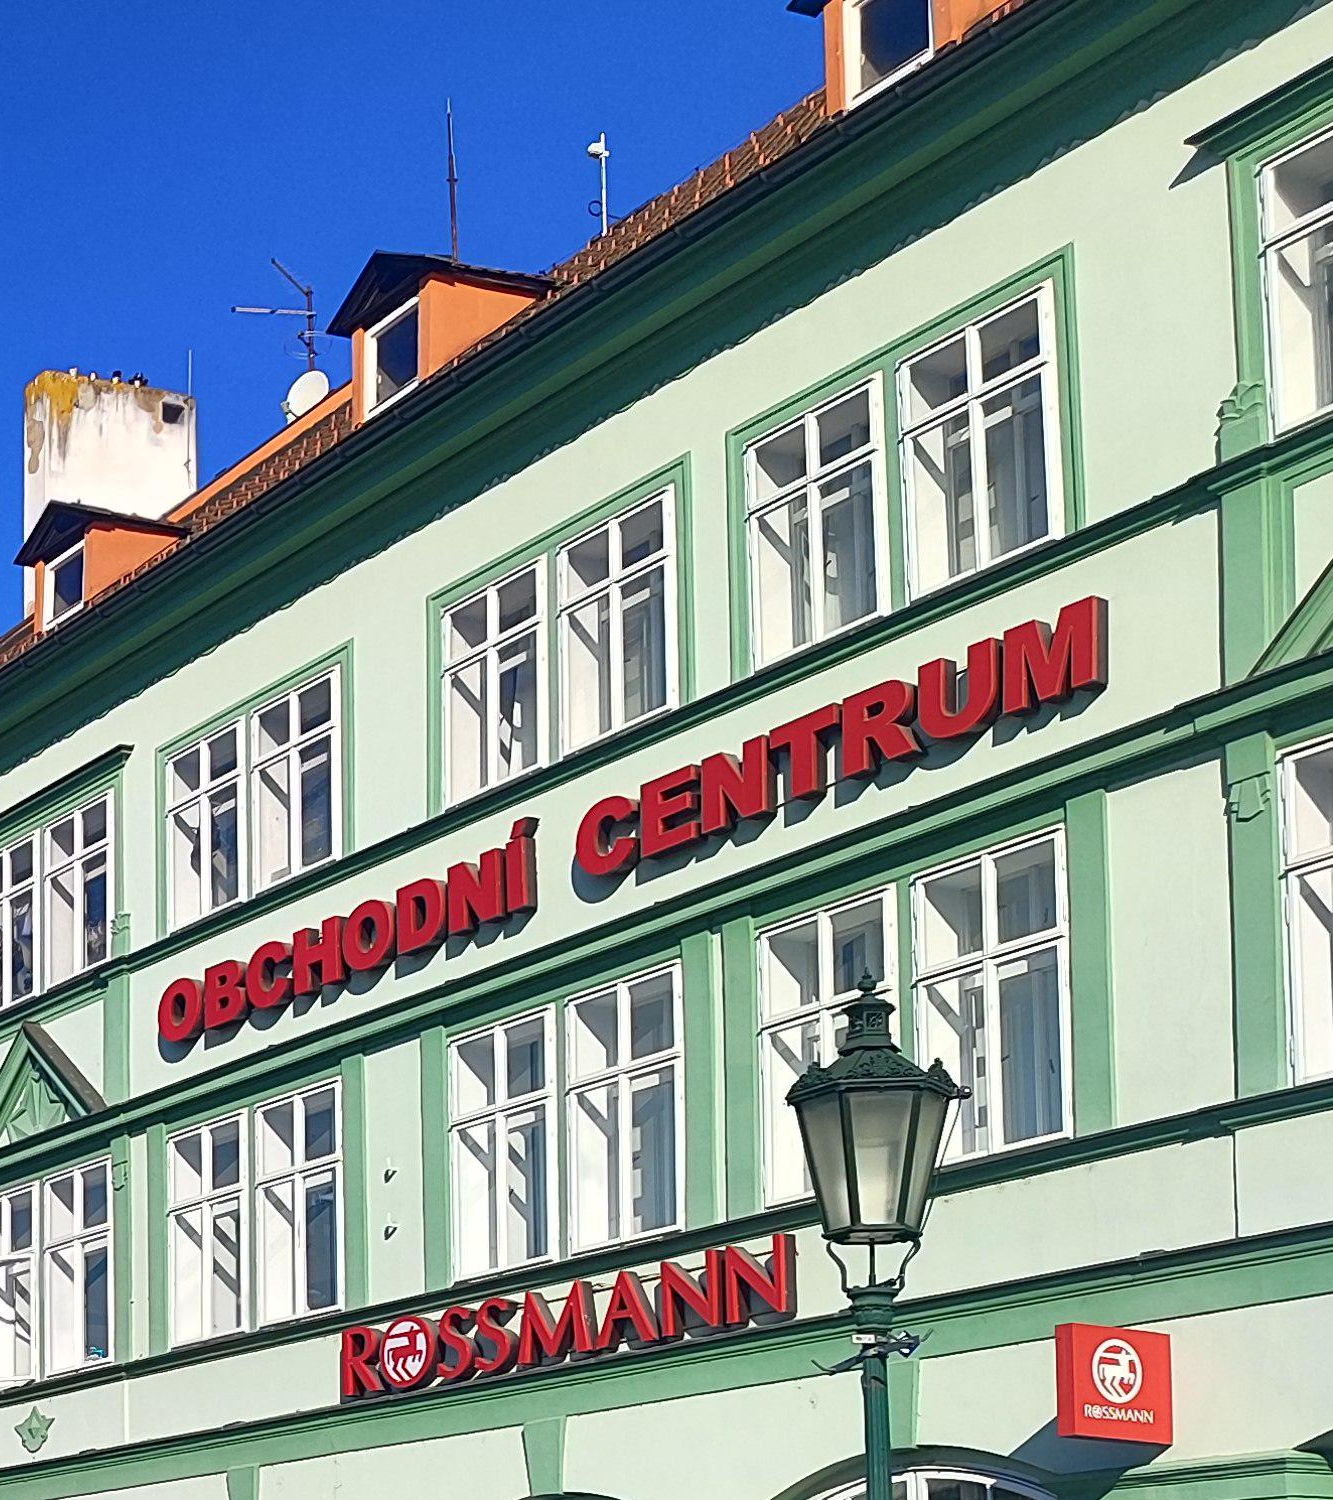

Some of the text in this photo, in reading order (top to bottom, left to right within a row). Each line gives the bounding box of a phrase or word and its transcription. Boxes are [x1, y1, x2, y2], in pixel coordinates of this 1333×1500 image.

[159, 596, 1109, 1042] OBCHODNÍ CENTRUM
[341, 1233, 796, 1399] ROSSMANN
[1084, 1404, 1154, 1424] ROSSMANN
